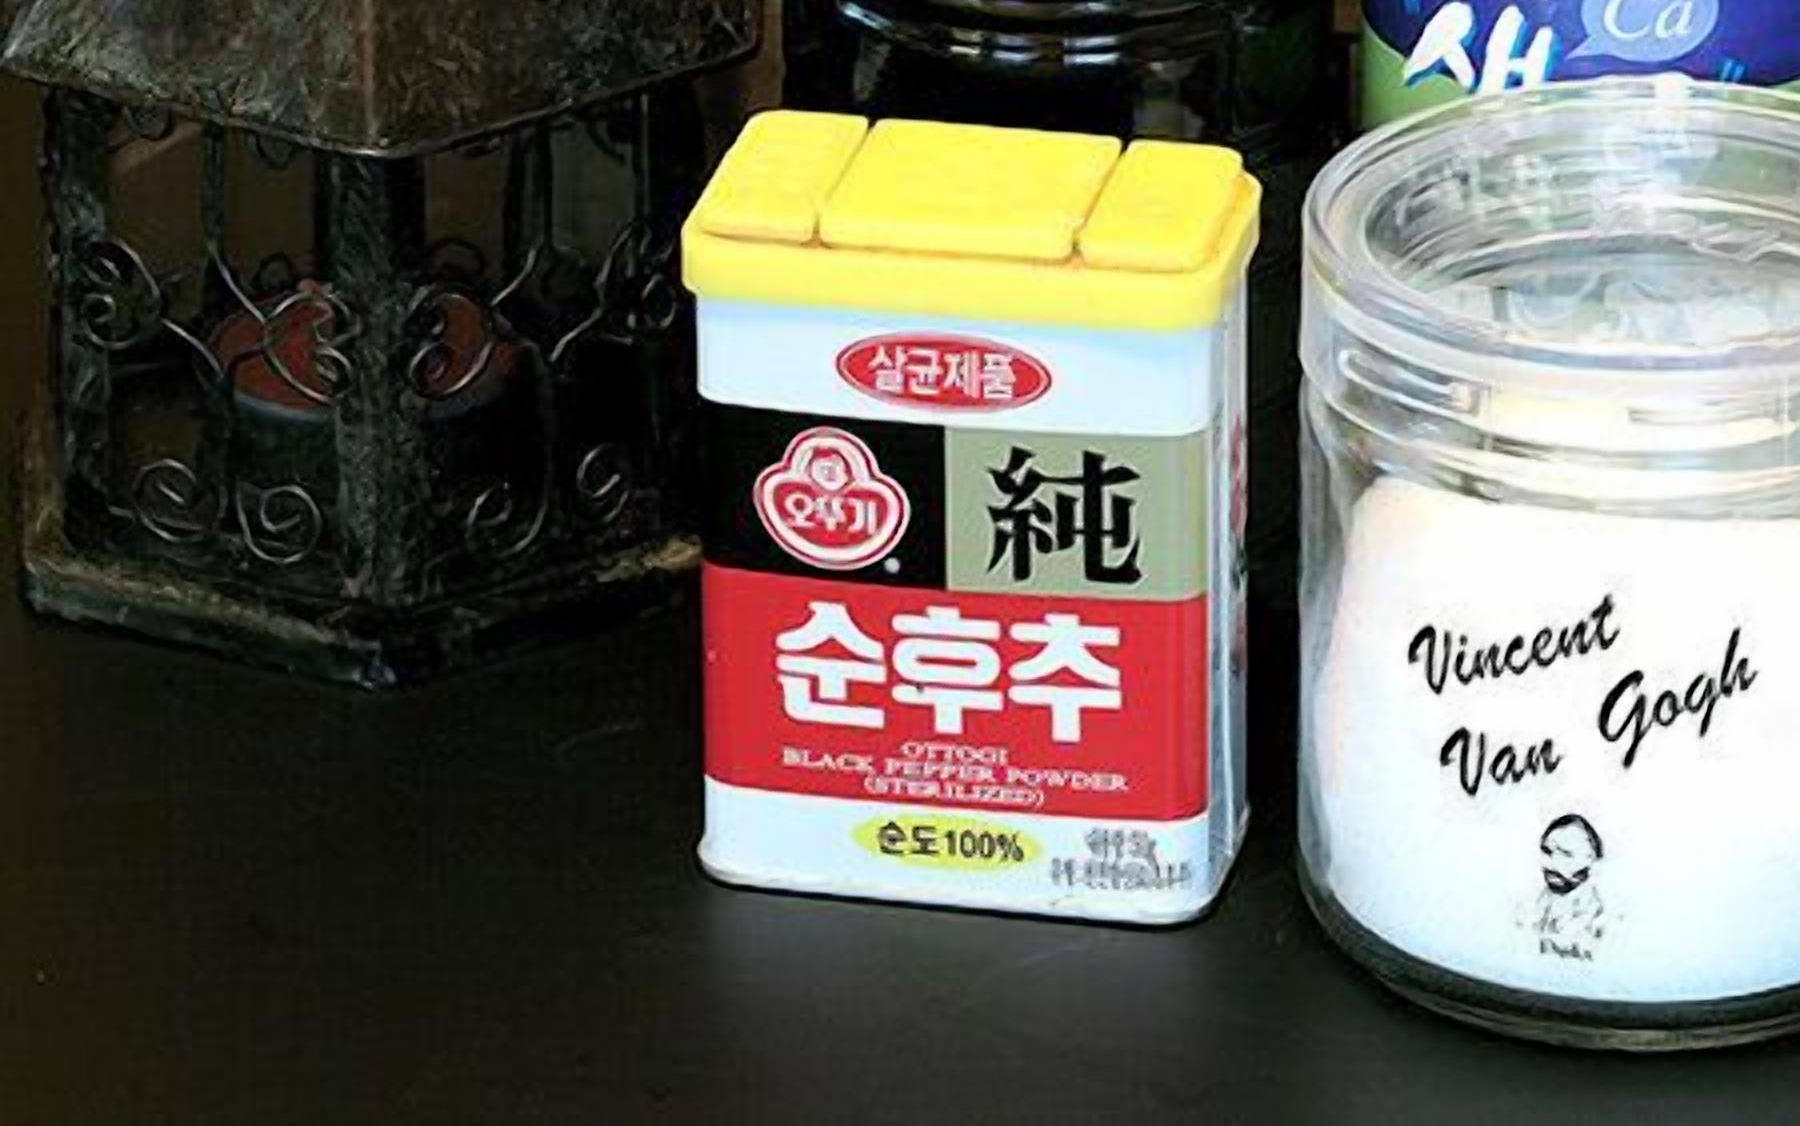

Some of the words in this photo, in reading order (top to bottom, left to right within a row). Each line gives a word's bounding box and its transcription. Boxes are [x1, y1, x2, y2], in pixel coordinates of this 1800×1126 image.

[868, 345, 1017, 400] 살균제품
[783, 492, 878, 535] 오뚜기
[988, 445, 1146, 584] 純
[775, 601, 1122, 744] 순후추
[1407, 593, 1621, 695] Vincent
[1439, 726, 1564, 796] Van
[1598, 627, 1759, 769] Gogh
[781, 746, 875, 774] BLACK
[886, 757, 997, 783] PEPPER
[1007, 769, 1129, 793] POWDER
[902, 741, 1008, 765] OTTOGI
